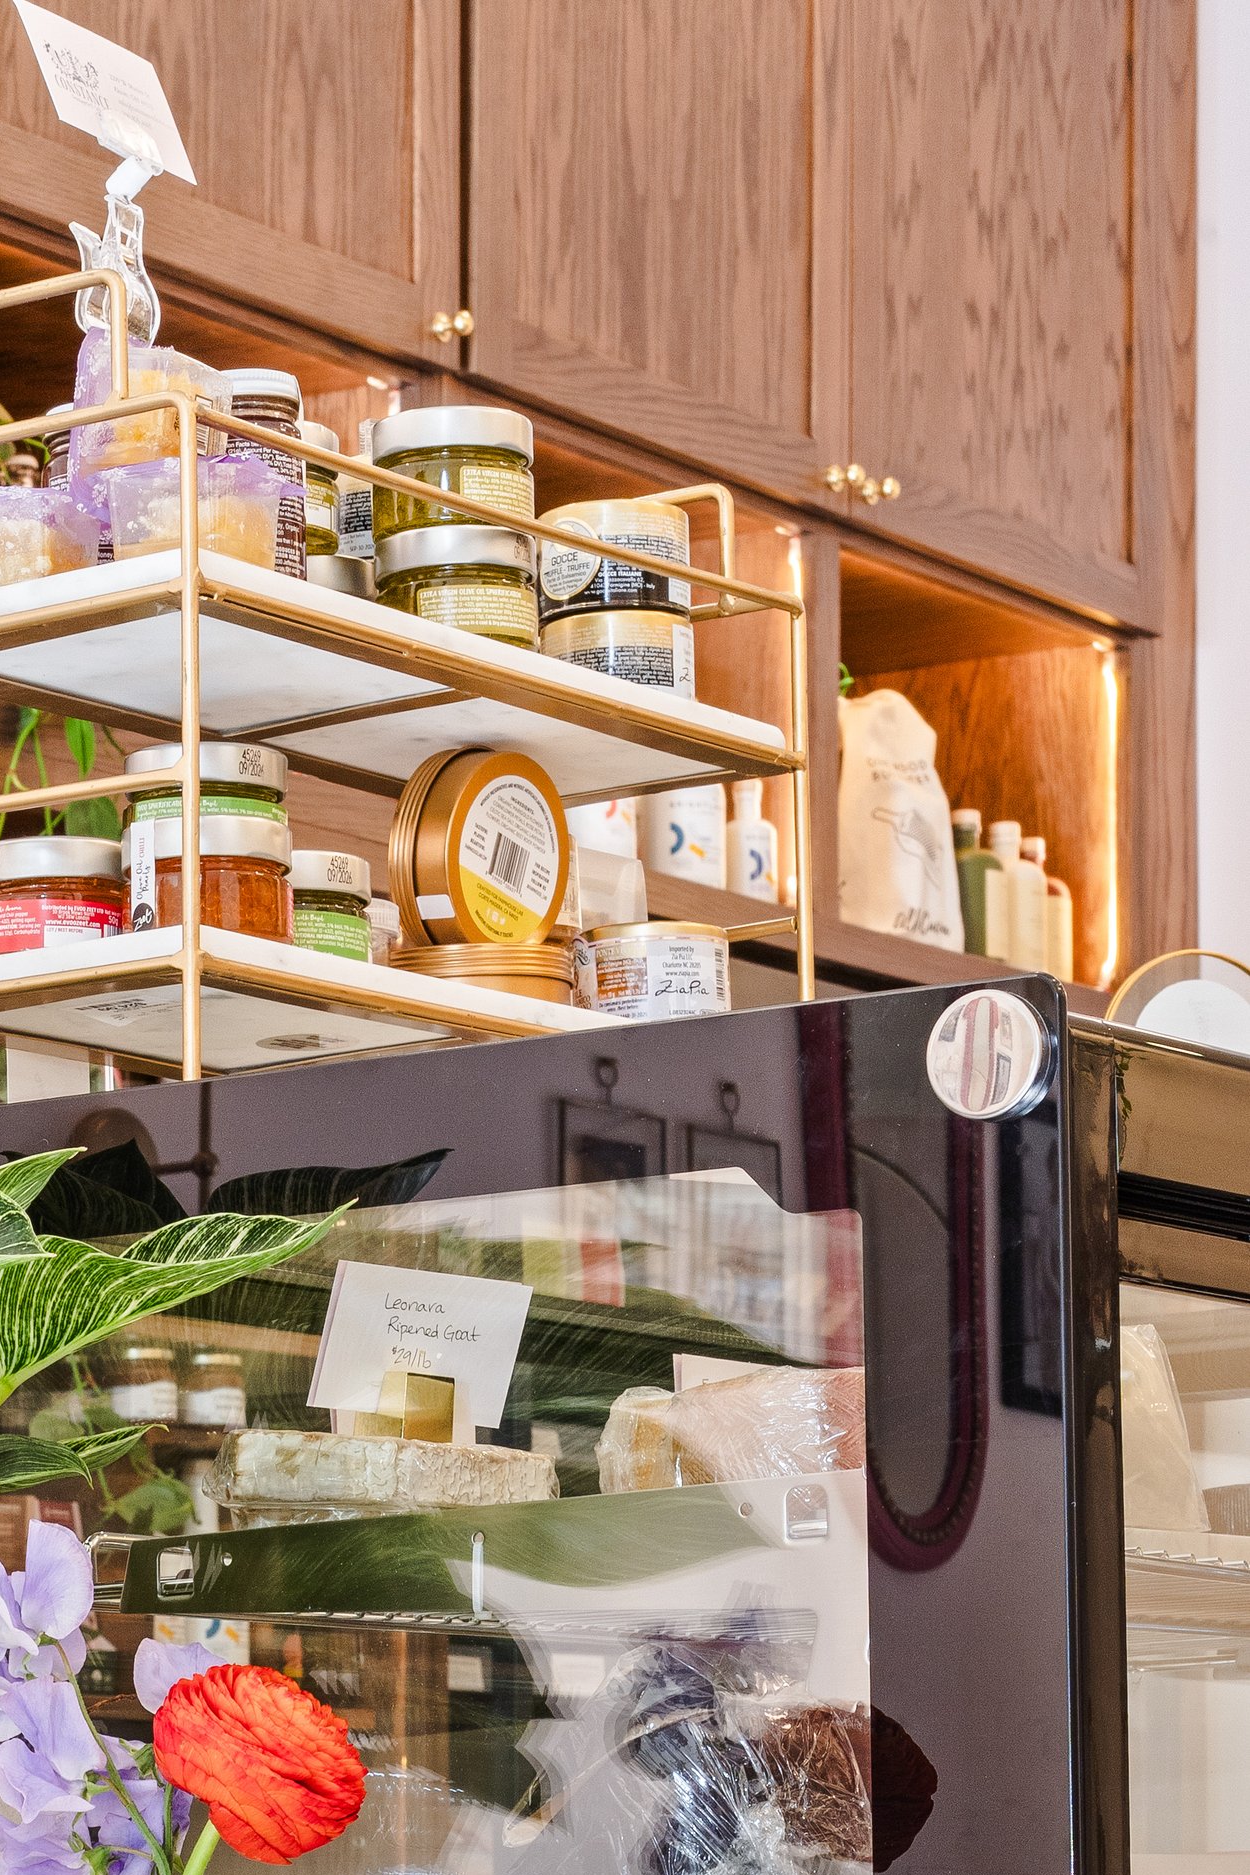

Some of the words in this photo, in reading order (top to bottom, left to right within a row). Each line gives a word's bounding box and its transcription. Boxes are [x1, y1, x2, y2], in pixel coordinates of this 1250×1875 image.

[551, 551, 579, 567] GOCCE
[241, 748, 262, 763] 45269
[330, 855, 350, 870] 45269
[326, 868, 353, 885] 09/2026
[107, 915, 119, 927] 50g
[387, 1315, 439, 1342] Ripened
[443, 1324, 482, 1342] Goat
